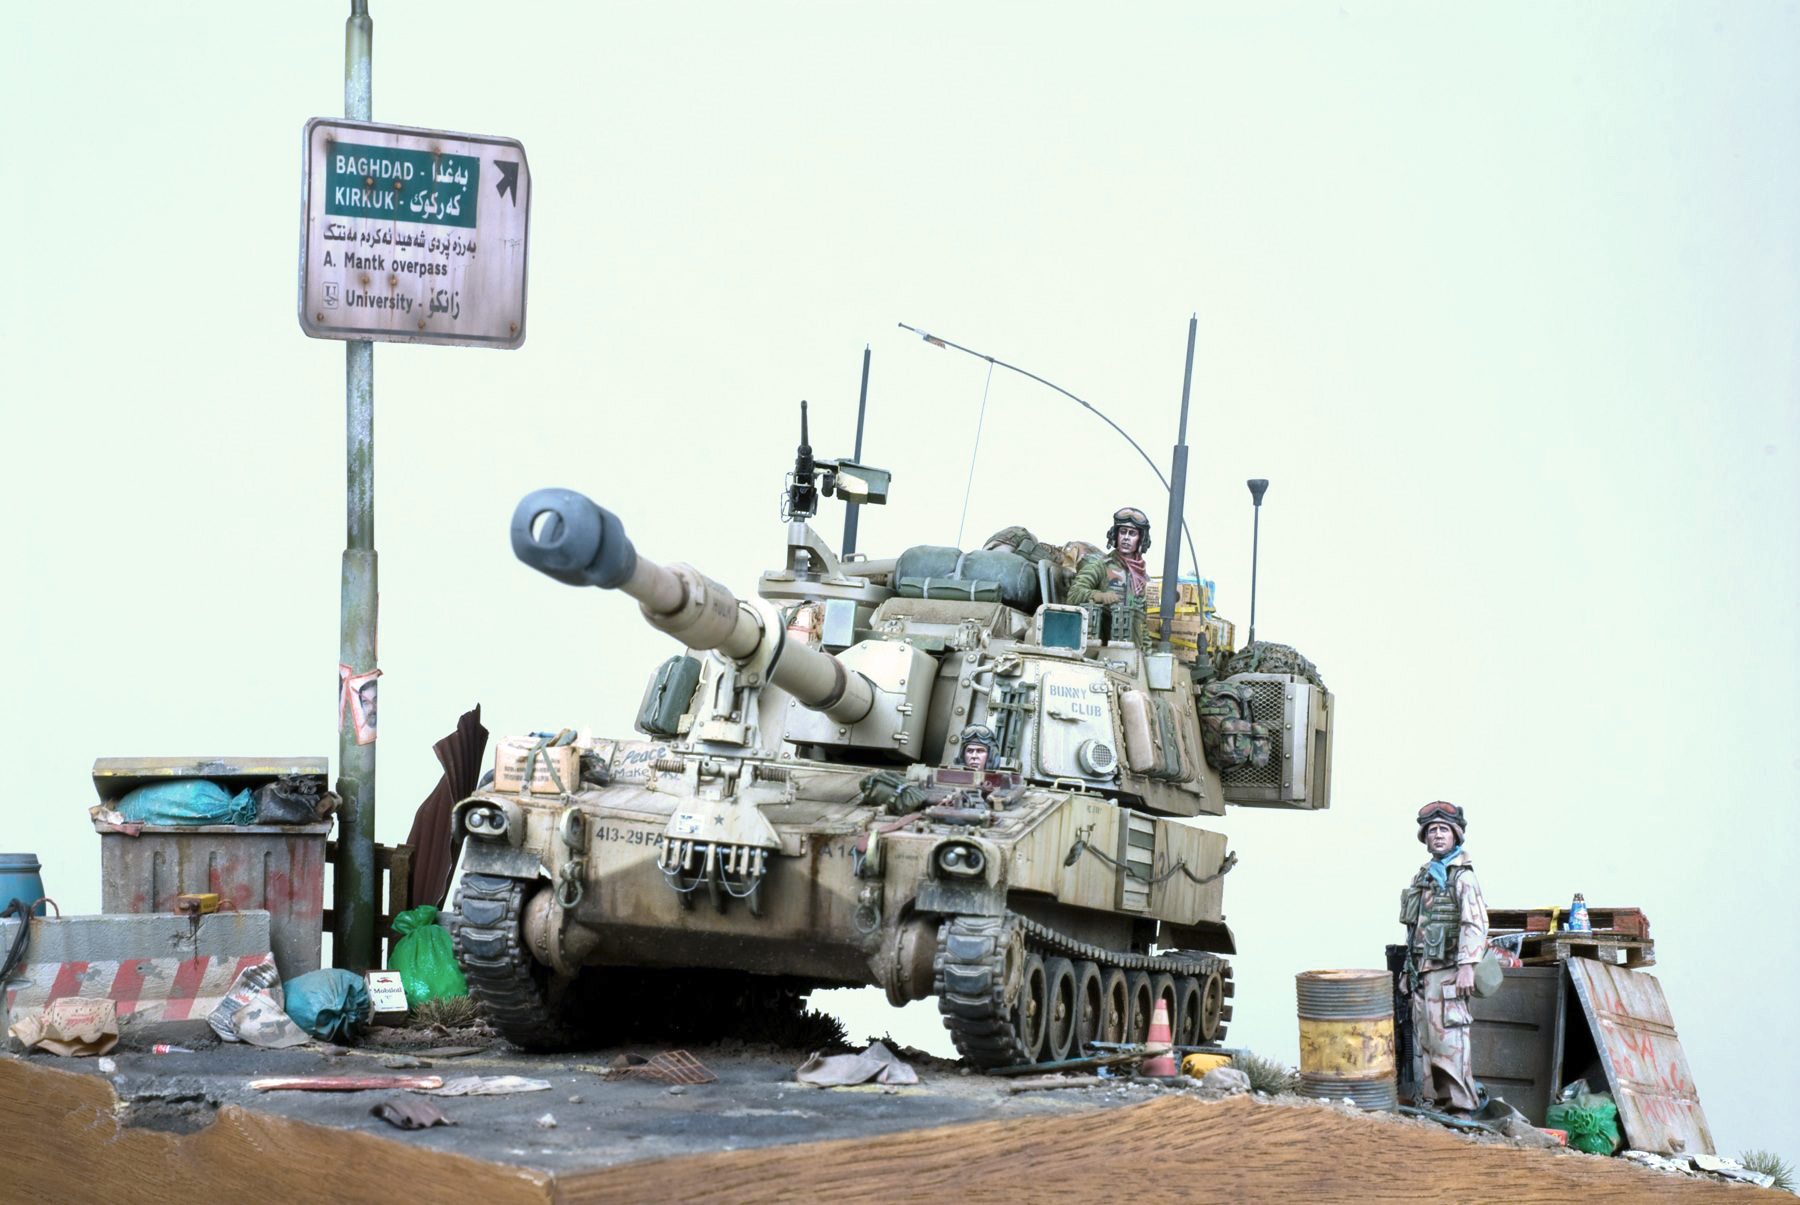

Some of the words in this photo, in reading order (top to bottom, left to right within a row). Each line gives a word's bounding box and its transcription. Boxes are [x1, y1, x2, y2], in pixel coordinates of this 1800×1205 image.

[336, 154, 414, 180] BAGHDAD
[335, 186, 395, 210] KIRKUK
[323, 250, 337, 268] A.
[344, 252, 385, 271] Mantk
[391, 259, 448, 278] overpass
[345, 288, 414, 314] University
[1049, 684, 1087, 700] BUNNY
[1071, 702, 1102, 717] CLUB
[596, 826, 664, 847] 413-29FA
